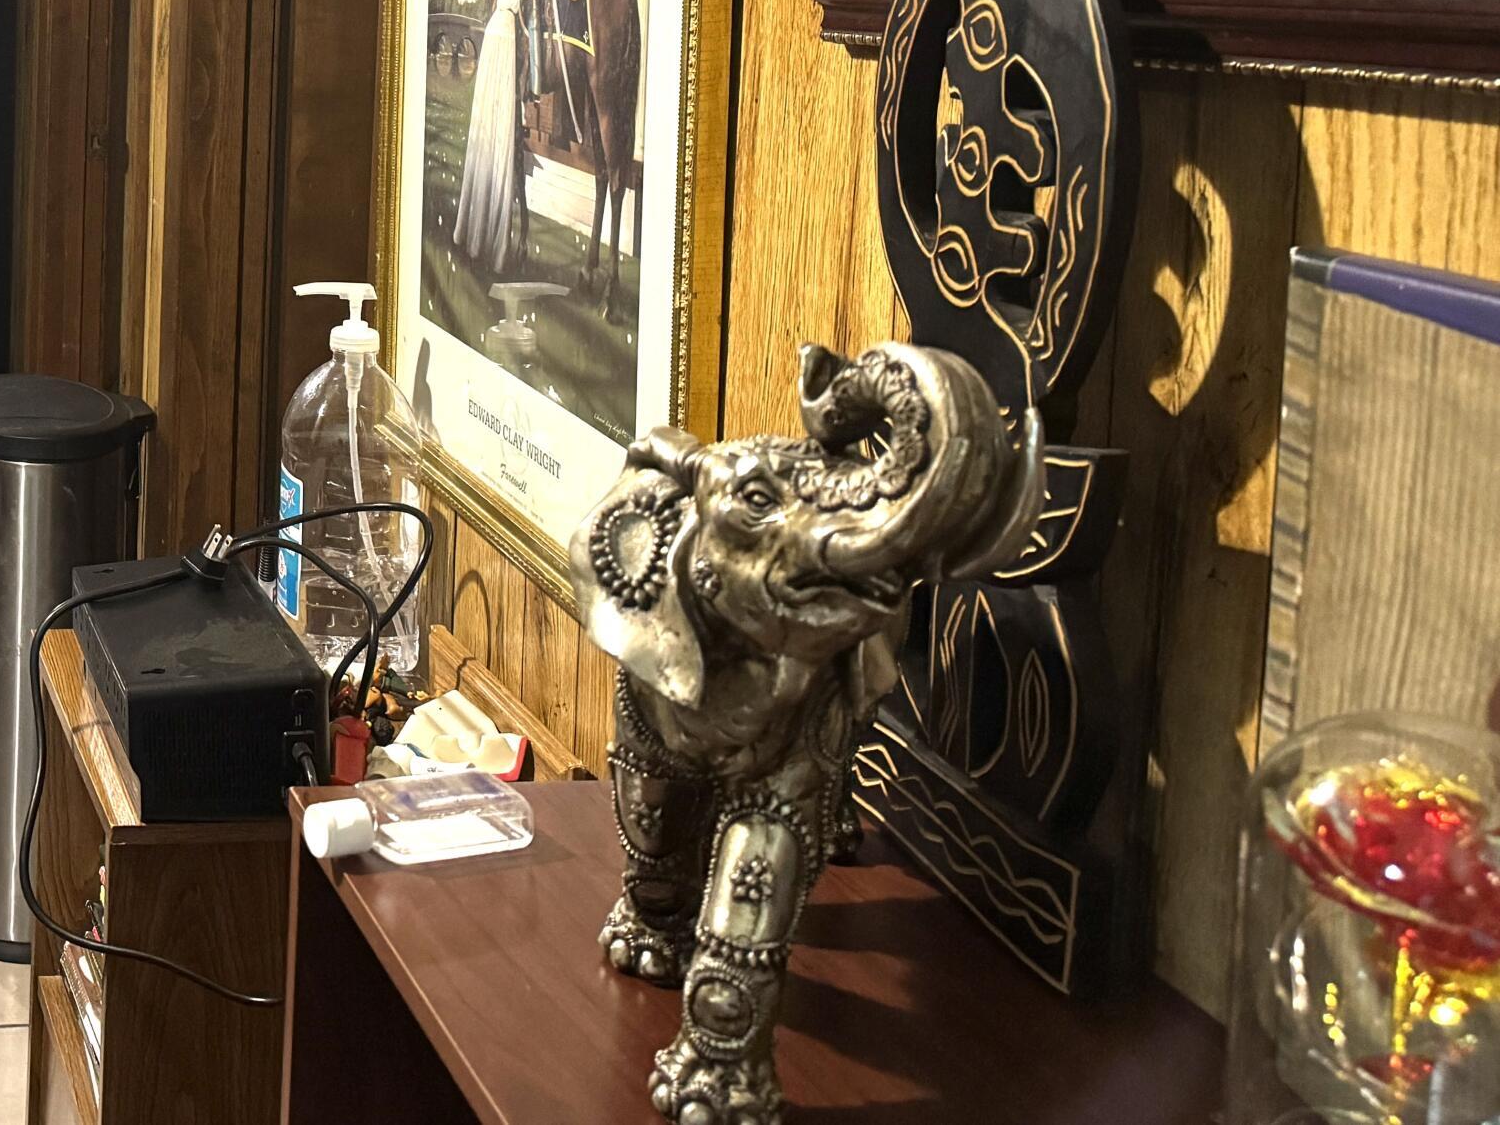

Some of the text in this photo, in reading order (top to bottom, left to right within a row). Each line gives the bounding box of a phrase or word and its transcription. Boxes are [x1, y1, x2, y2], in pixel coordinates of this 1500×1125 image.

[468, 399, 562, 480] EDWARD CLAY WRIGHT
